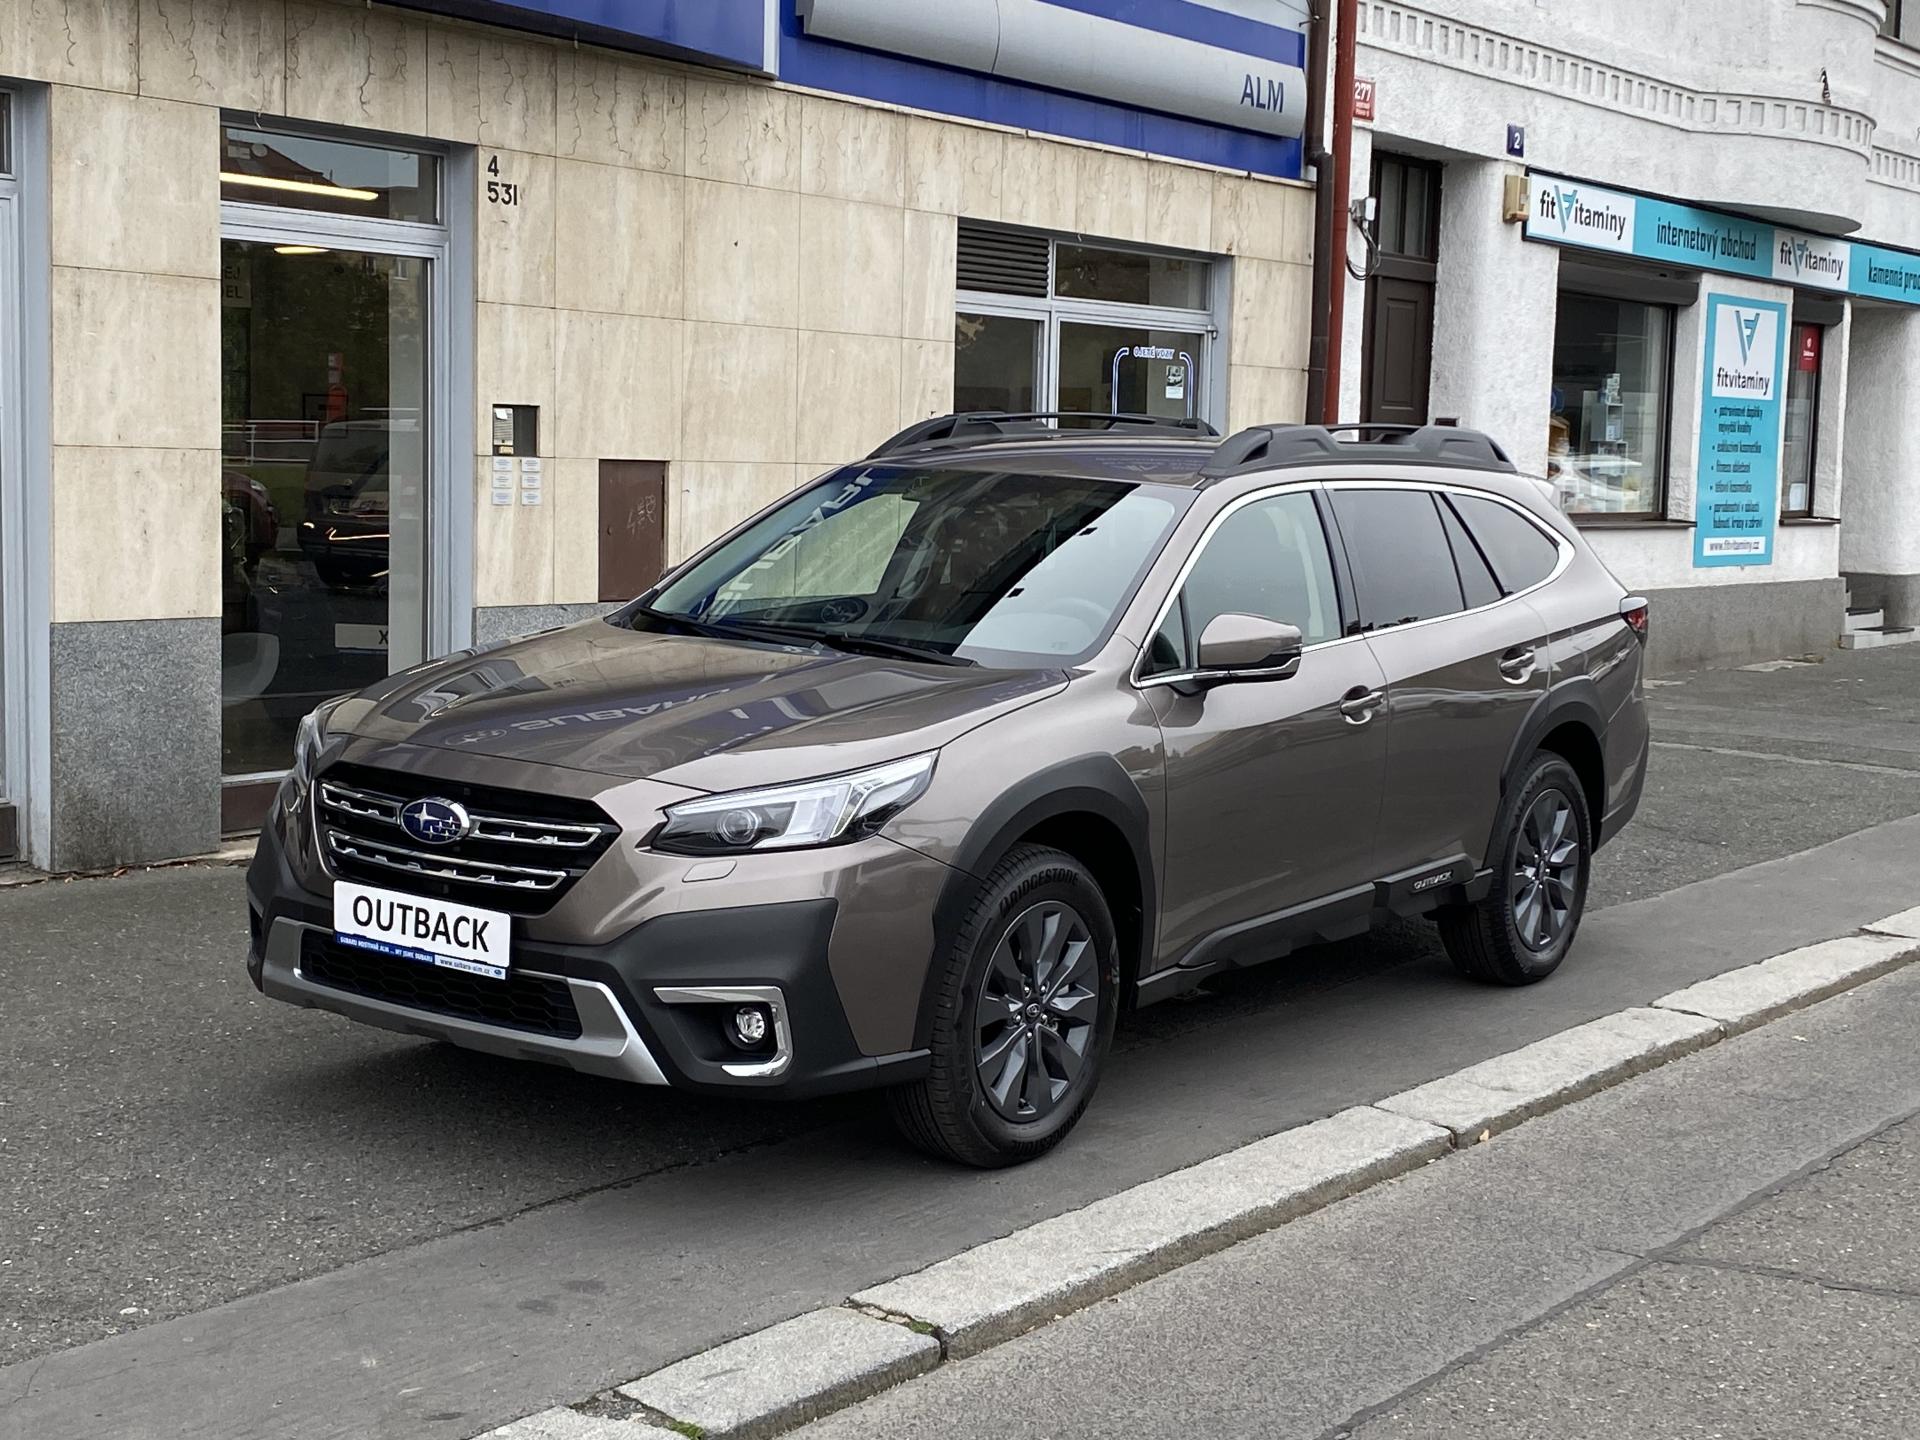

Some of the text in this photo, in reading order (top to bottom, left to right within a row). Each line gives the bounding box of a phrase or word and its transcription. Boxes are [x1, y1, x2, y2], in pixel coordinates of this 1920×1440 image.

[1240, 73, 1284, 113] ALM
[1354, 82, 1372, 102] 277
[1513, 132, 1521, 149] 2
[487, 155, 500, 177] 4
[487, 181, 518, 206] 531
[1656, 217, 1757, 261] internetový obchod
[1868, 256, 1903, 288] kamenná
[1717, 366, 1770, 396] fitvitaminy
[998, 867, 1080, 919] BRIDGESTONE
[1413, 871, 1453, 890] OUTBACK
[352, 895, 490, 953] OUTBACK
